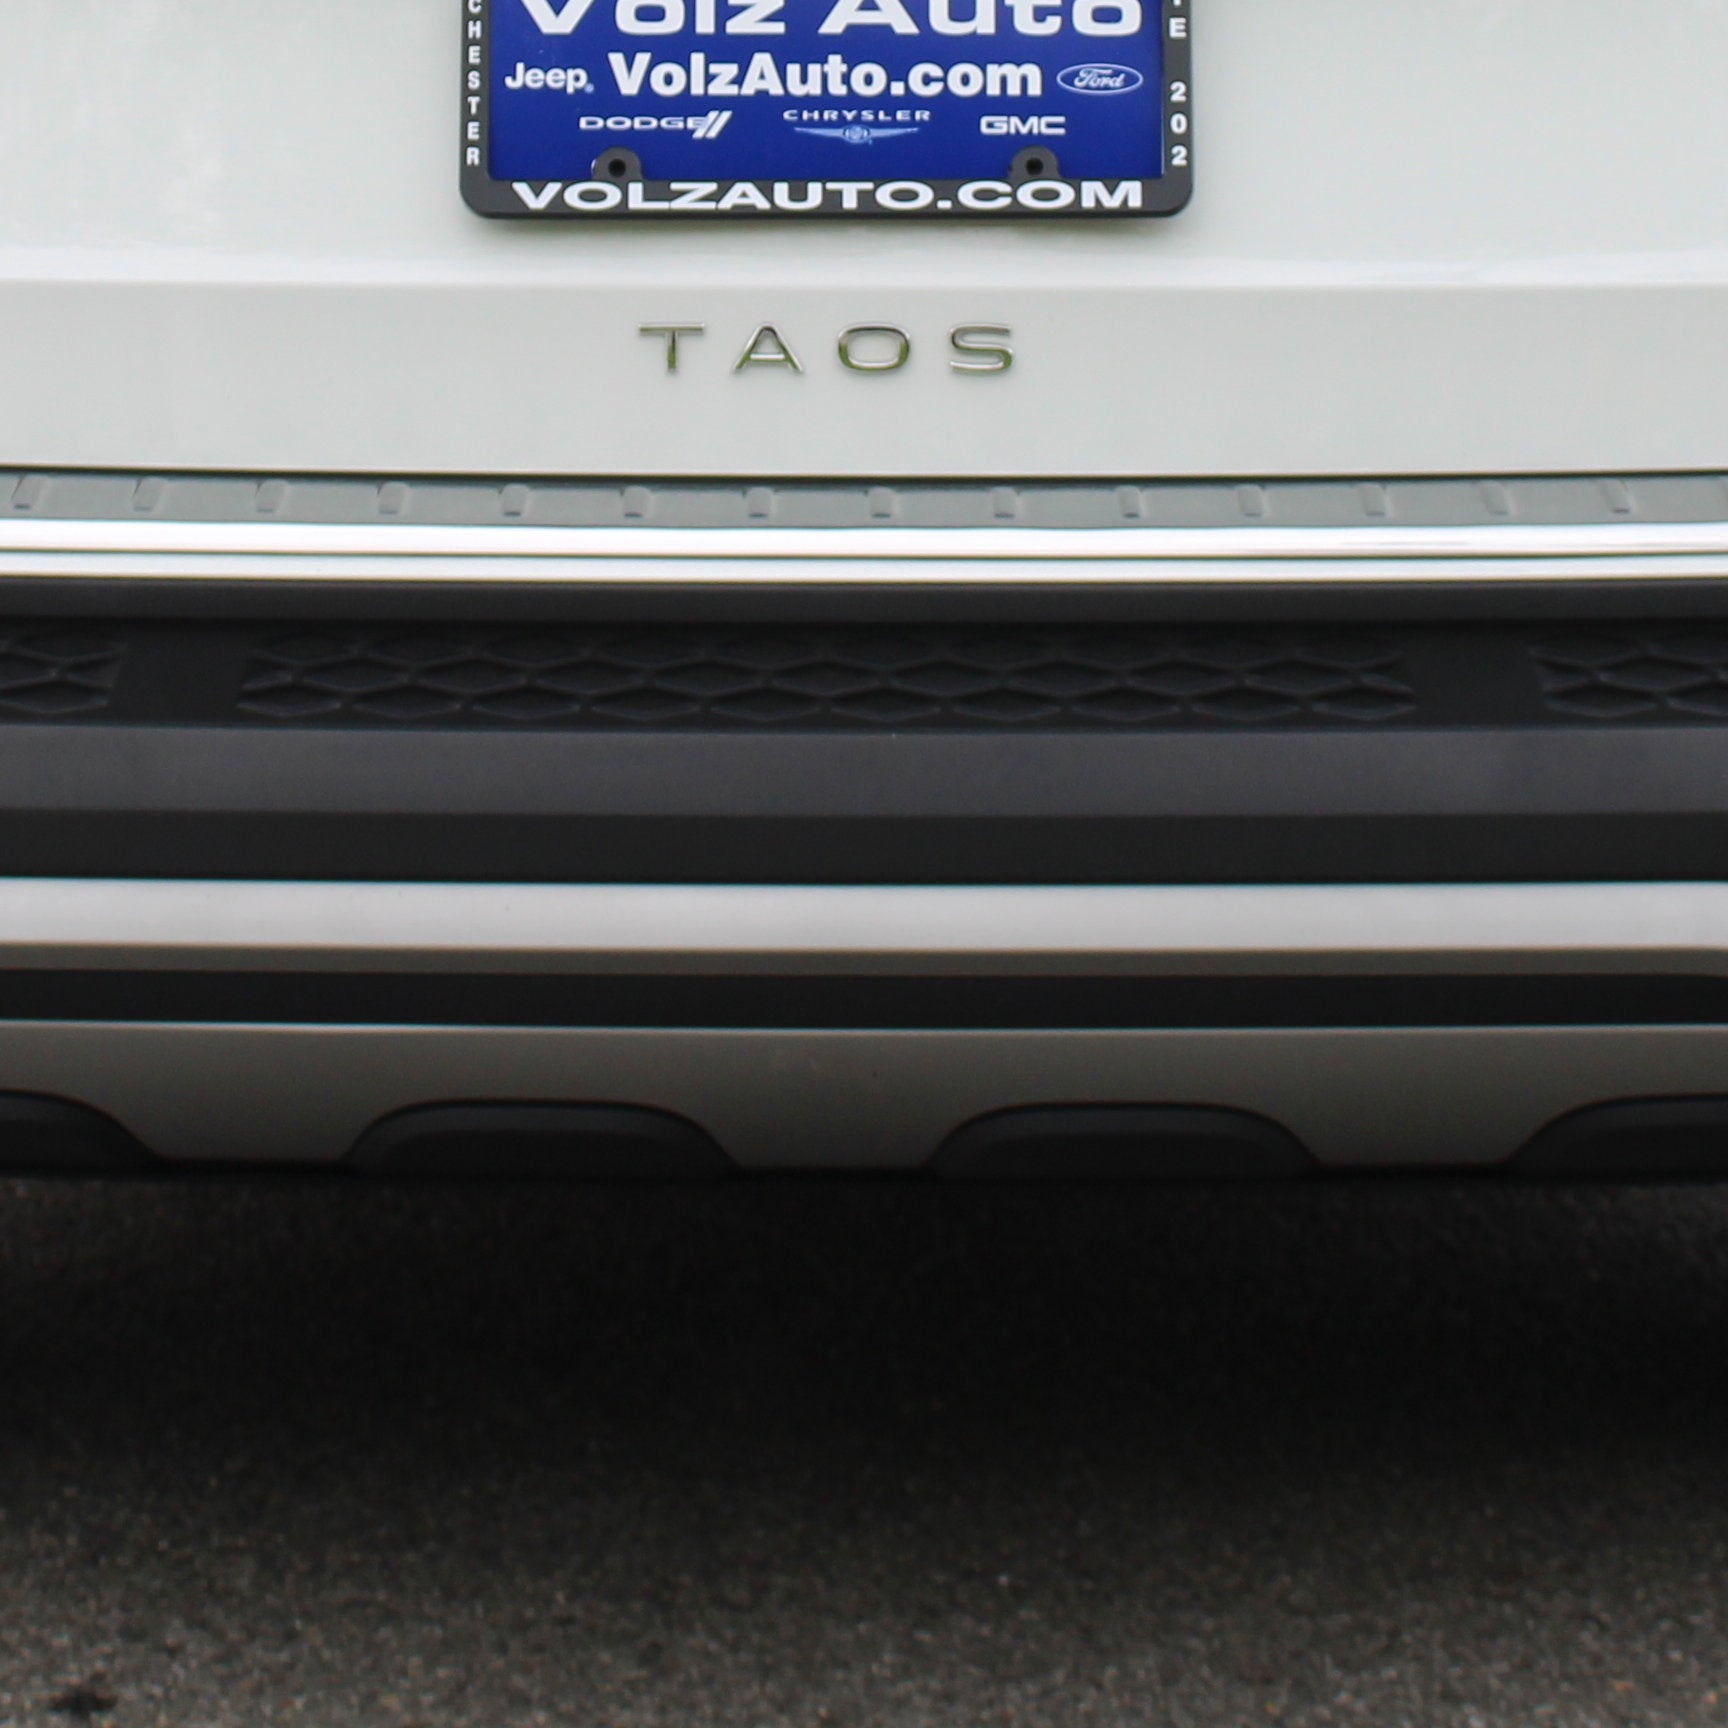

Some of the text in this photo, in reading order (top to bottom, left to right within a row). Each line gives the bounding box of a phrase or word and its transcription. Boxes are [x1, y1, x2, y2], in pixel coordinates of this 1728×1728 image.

[607, 52, 1043, 98] VolzAuto.com
[579, 115, 711, 132] DODGE
[782, 109, 932, 121] CHRYSLER
[979, 115, 1066, 136] GMC
[1170, 82, 1188, 166] 202
[511, 180, 1143, 211] VOLZAUTO.COM
[638, 322, 1014, 373] TAOS
